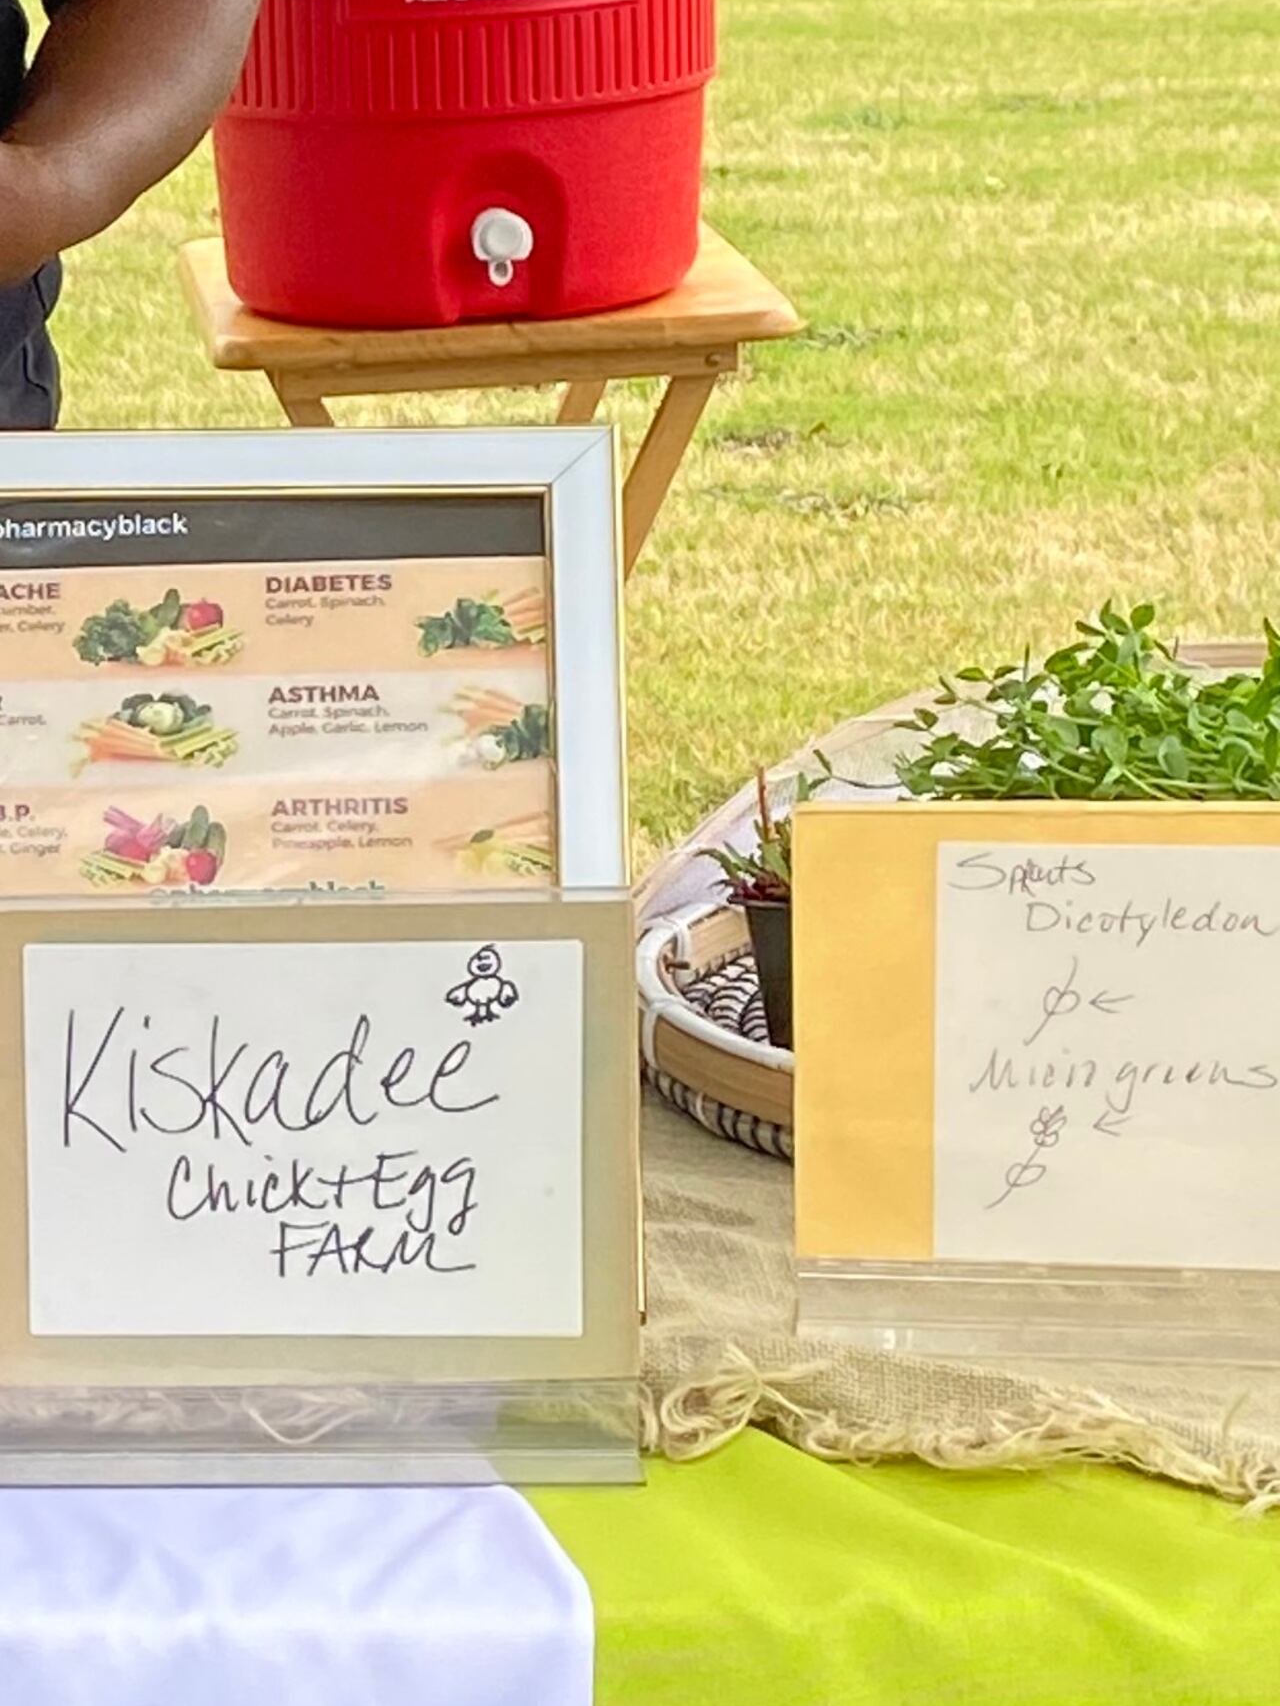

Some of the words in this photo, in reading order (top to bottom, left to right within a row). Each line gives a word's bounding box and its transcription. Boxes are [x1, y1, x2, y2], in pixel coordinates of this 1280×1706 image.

[265, 574, 392, 594] DIABETES
[17, 620, 65, 634] Celery
[265, 614, 315, 628] Celery
[268, 685, 380, 704] ASTHMA
[374, 722, 428, 734] Lemon
[271, 797, 409, 817] ARTHRITIS
[10, 841, 61, 858] Ginger
[358, 836, 413, 849] Lemon
[1026, 899, 1279, 946] Dicotyledon
[64, 1006, 500, 1152] Kiskadee
